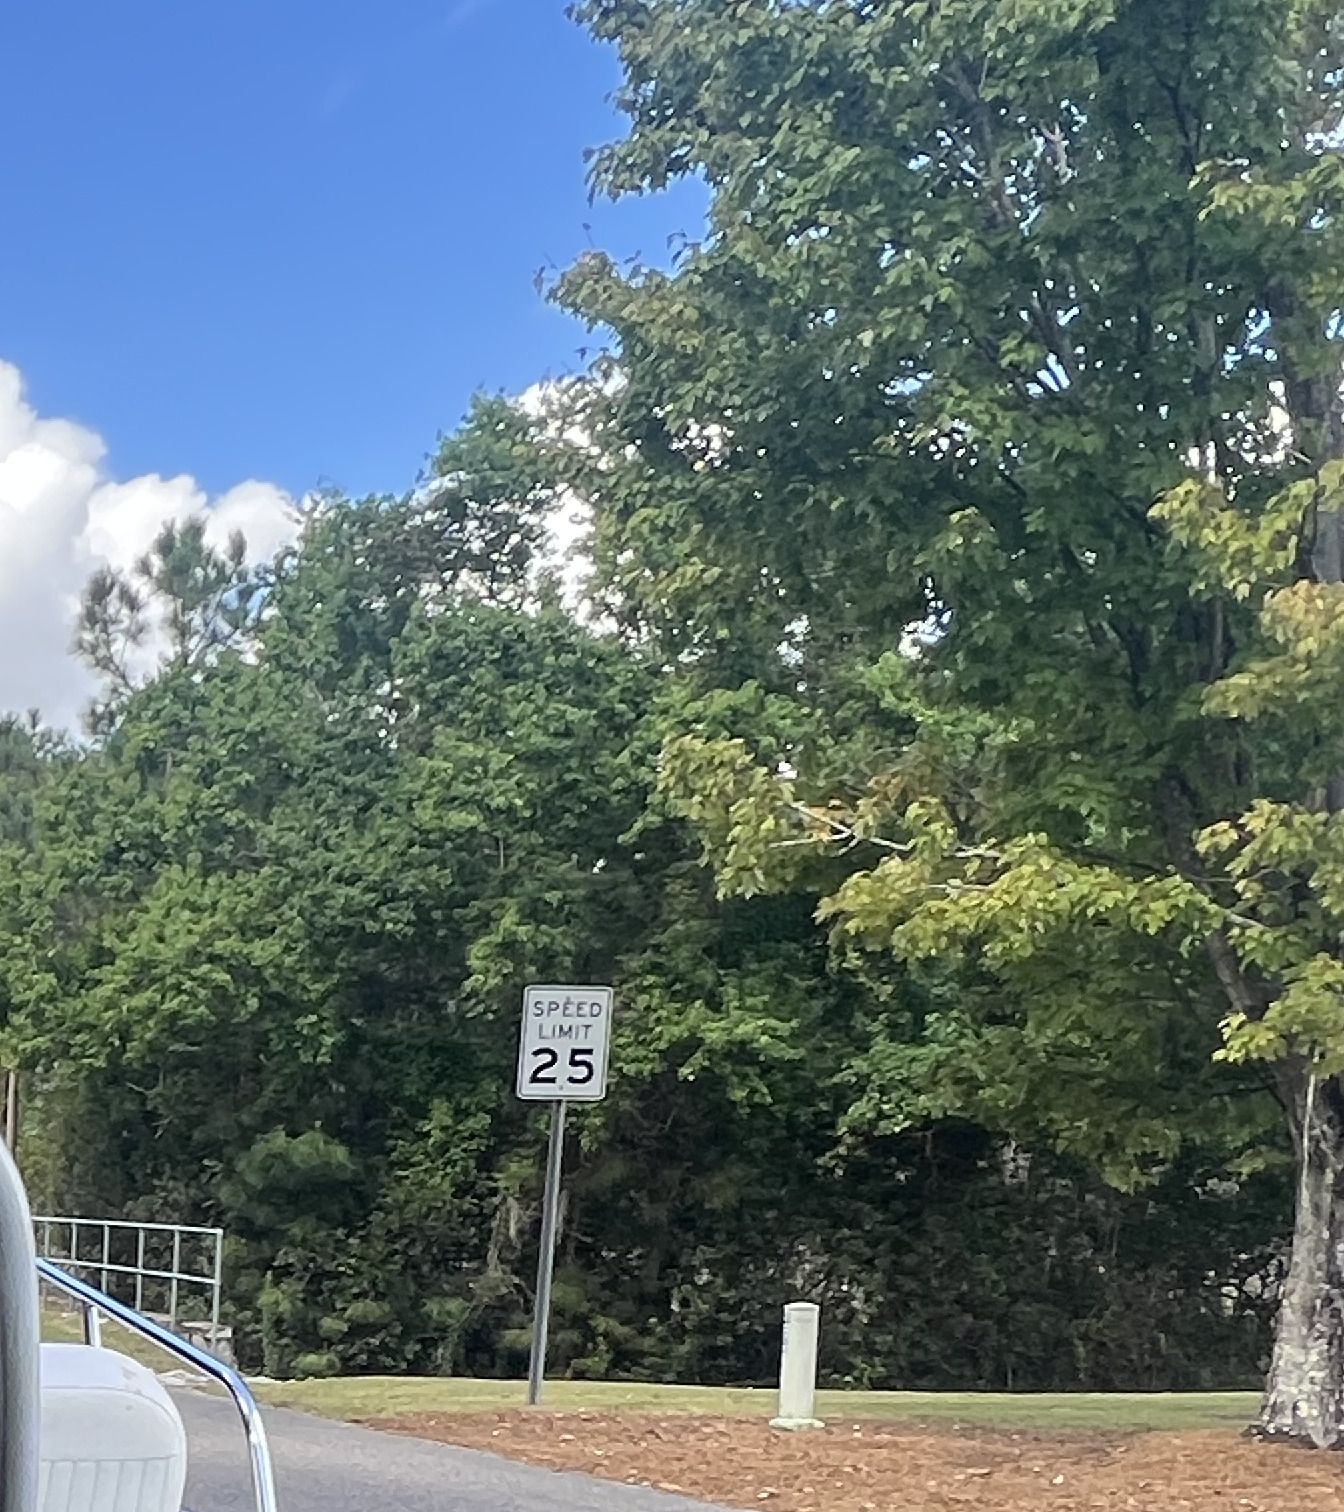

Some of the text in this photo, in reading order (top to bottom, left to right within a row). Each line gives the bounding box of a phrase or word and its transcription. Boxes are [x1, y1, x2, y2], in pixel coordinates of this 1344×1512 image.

[532, 1000, 602, 1018] SPEED
[538, 1023, 593, 1040] LIMIT
[529, 1047, 594, 1084] 25
